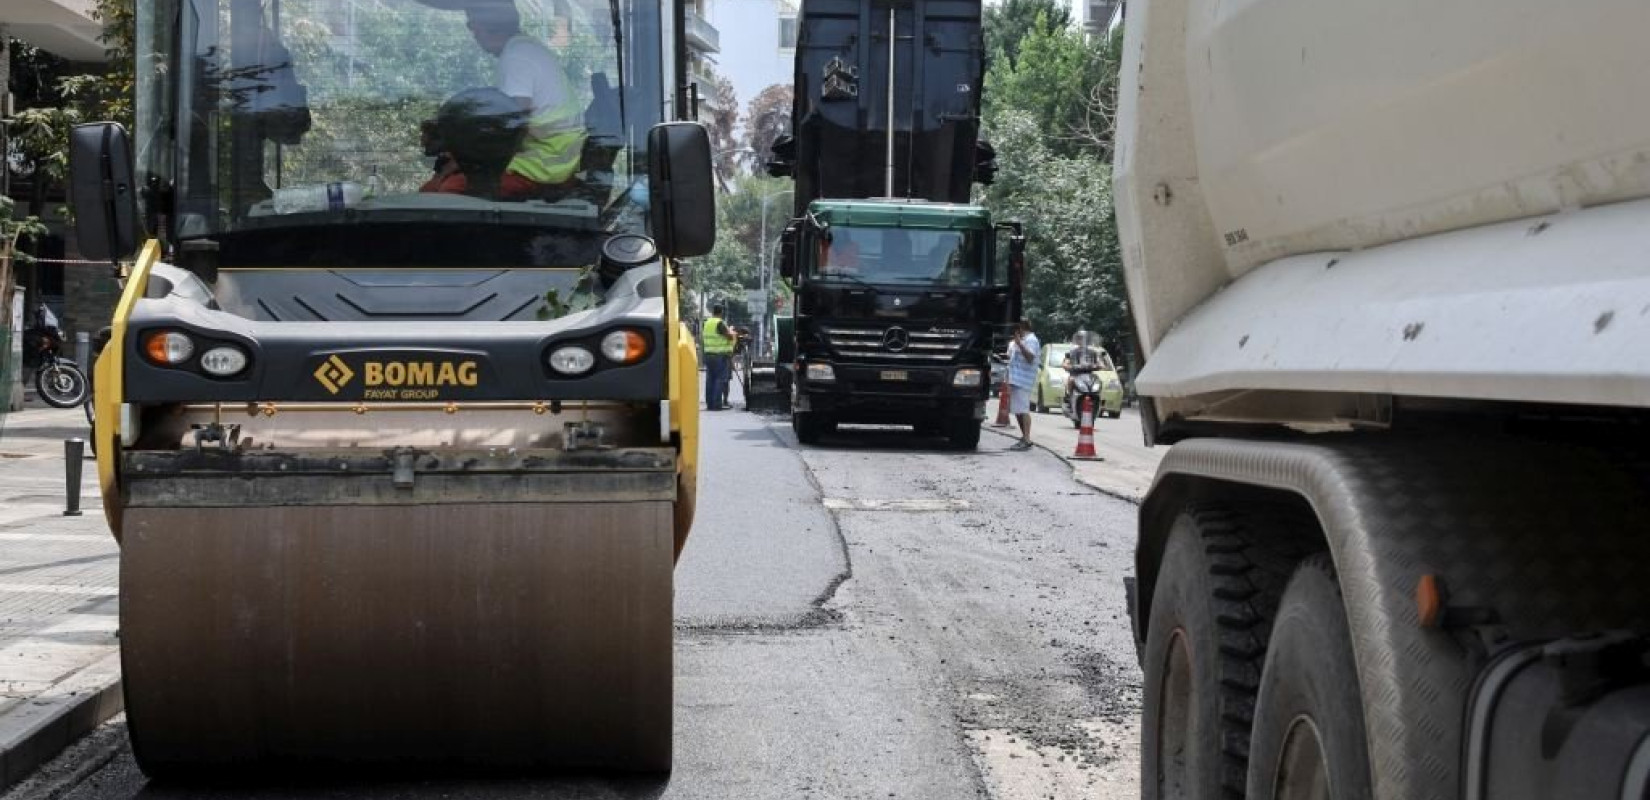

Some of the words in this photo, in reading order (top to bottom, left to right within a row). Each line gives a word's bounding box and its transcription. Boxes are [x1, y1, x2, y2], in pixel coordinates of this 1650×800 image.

[365, 361, 478, 386] BOMAG
[365, 389, 398, 399] FAYAT
[400, 389, 439, 399] GROUP
